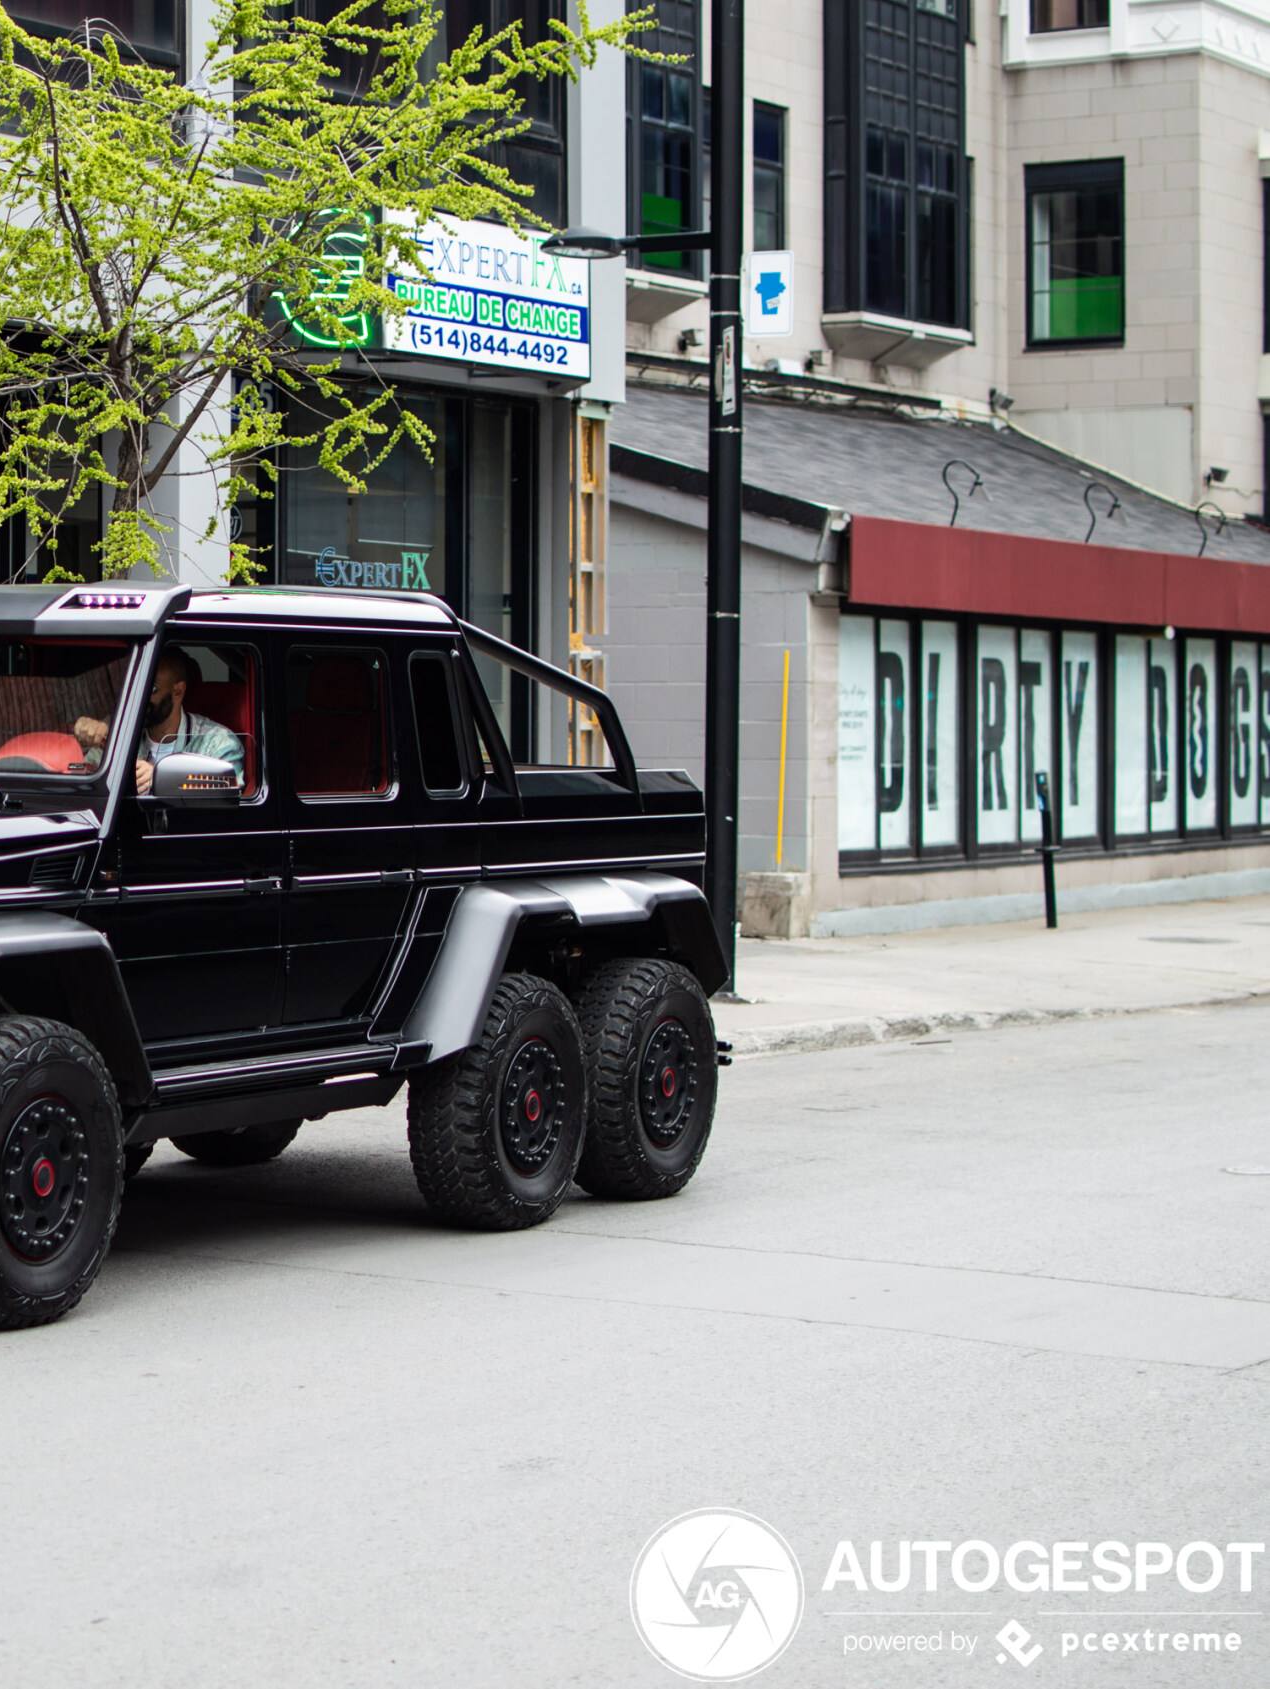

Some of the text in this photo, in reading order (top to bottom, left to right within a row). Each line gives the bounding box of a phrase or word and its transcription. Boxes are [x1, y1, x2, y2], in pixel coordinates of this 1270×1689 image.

[396, 282, 580, 336] BUREAU DE CHANGE
[411, 322, 569, 366] (514)844-4492
[879, 651, 1091, 813] DIRTY
